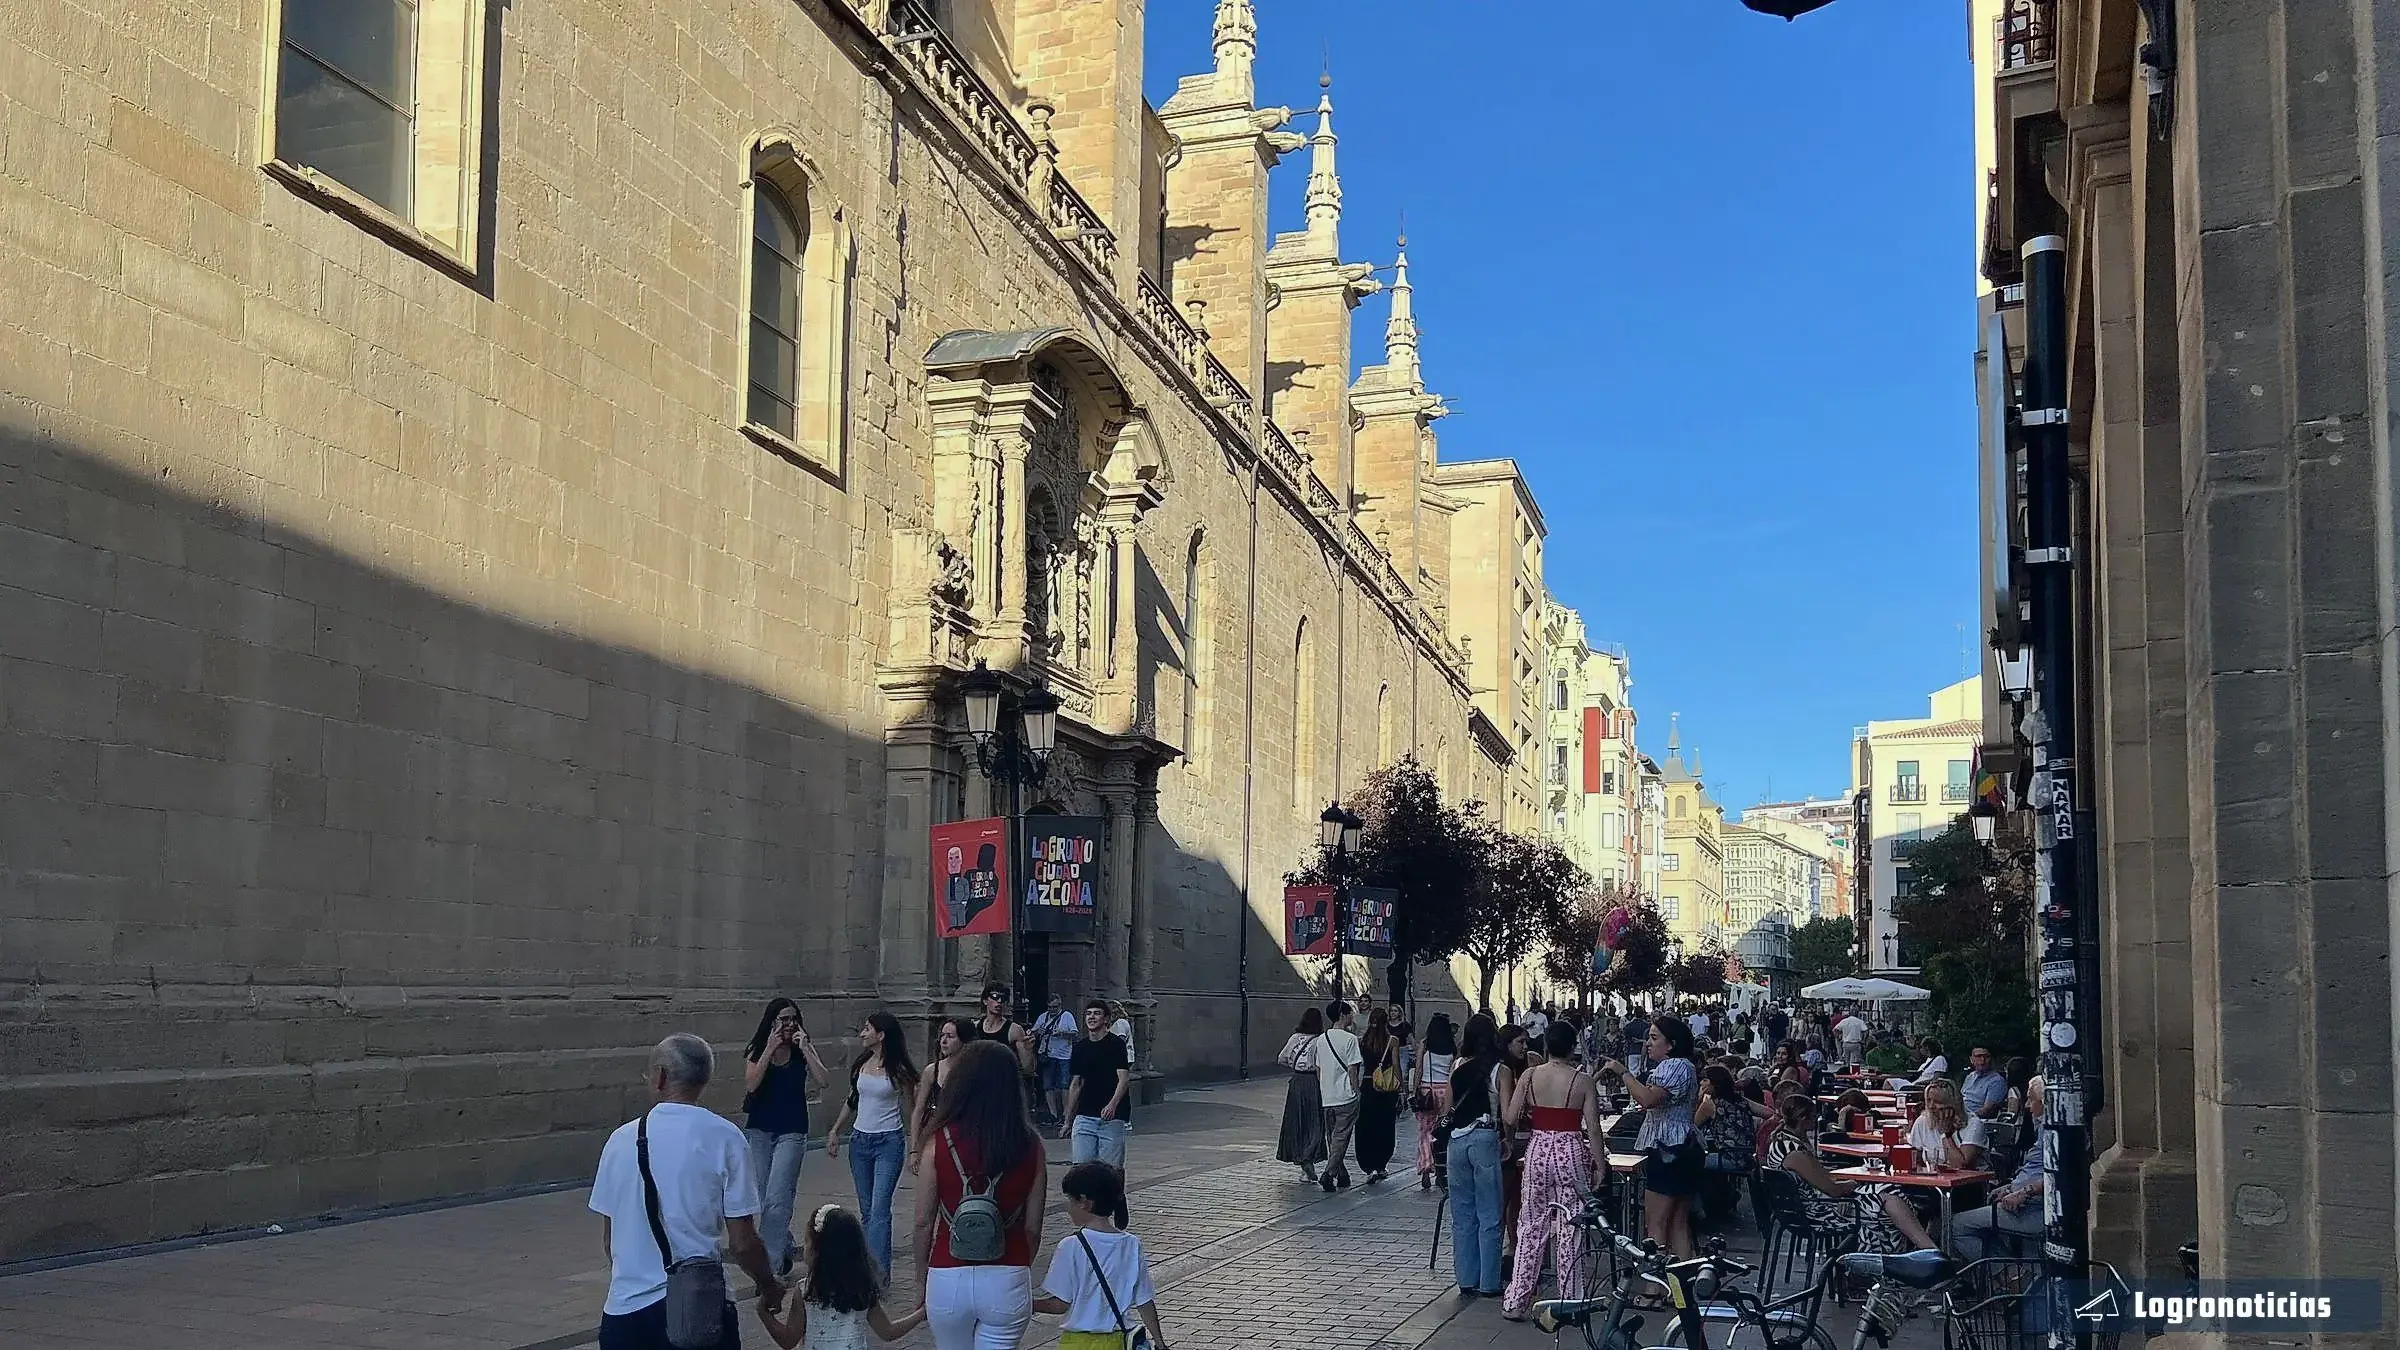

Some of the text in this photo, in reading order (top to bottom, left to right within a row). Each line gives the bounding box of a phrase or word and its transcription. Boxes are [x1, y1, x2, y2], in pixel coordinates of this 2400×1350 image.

[2052, 781, 2073, 837] NAKAR
[1026, 879, 1093, 906] AZCONA
[1347, 924, 1391, 942] AZCONA
